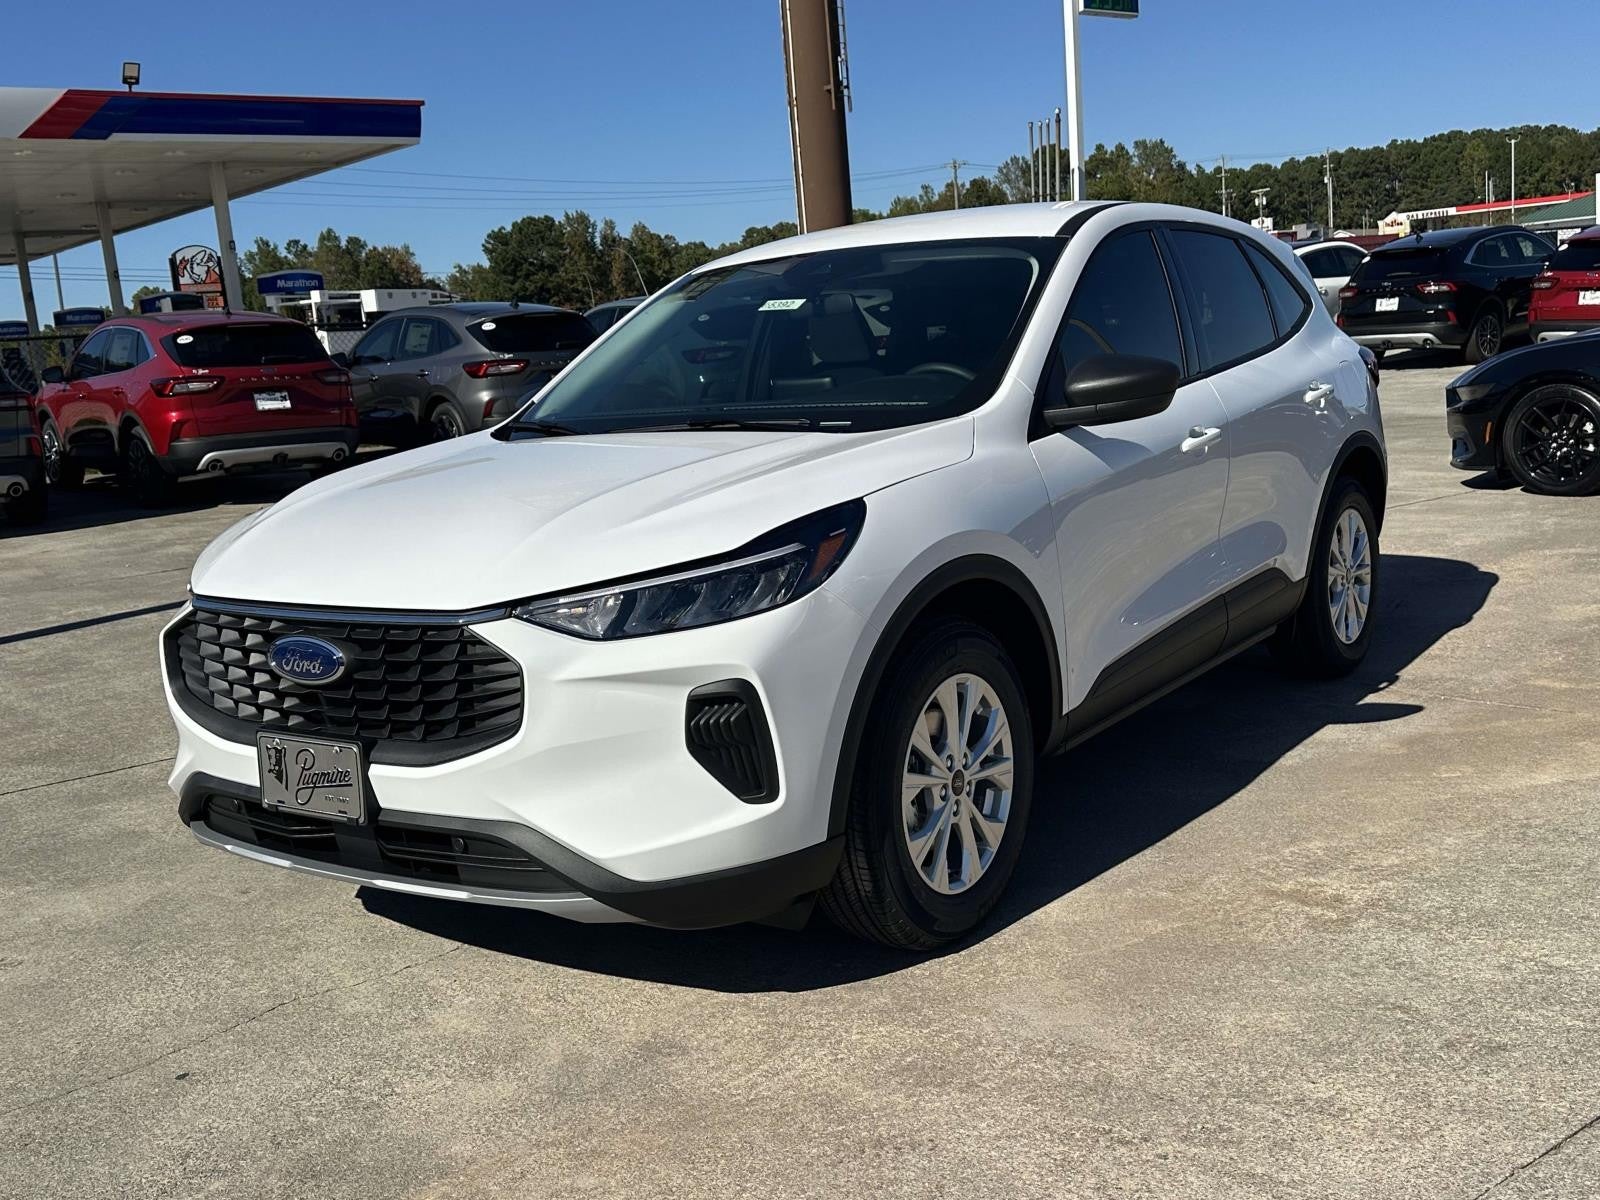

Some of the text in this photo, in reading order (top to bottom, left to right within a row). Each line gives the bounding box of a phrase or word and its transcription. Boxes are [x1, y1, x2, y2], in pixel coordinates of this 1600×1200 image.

[276, 279, 319, 289] Marathon
[283, 645, 324, 674] Ford
[295, 747, 354, 806] Pugmire
